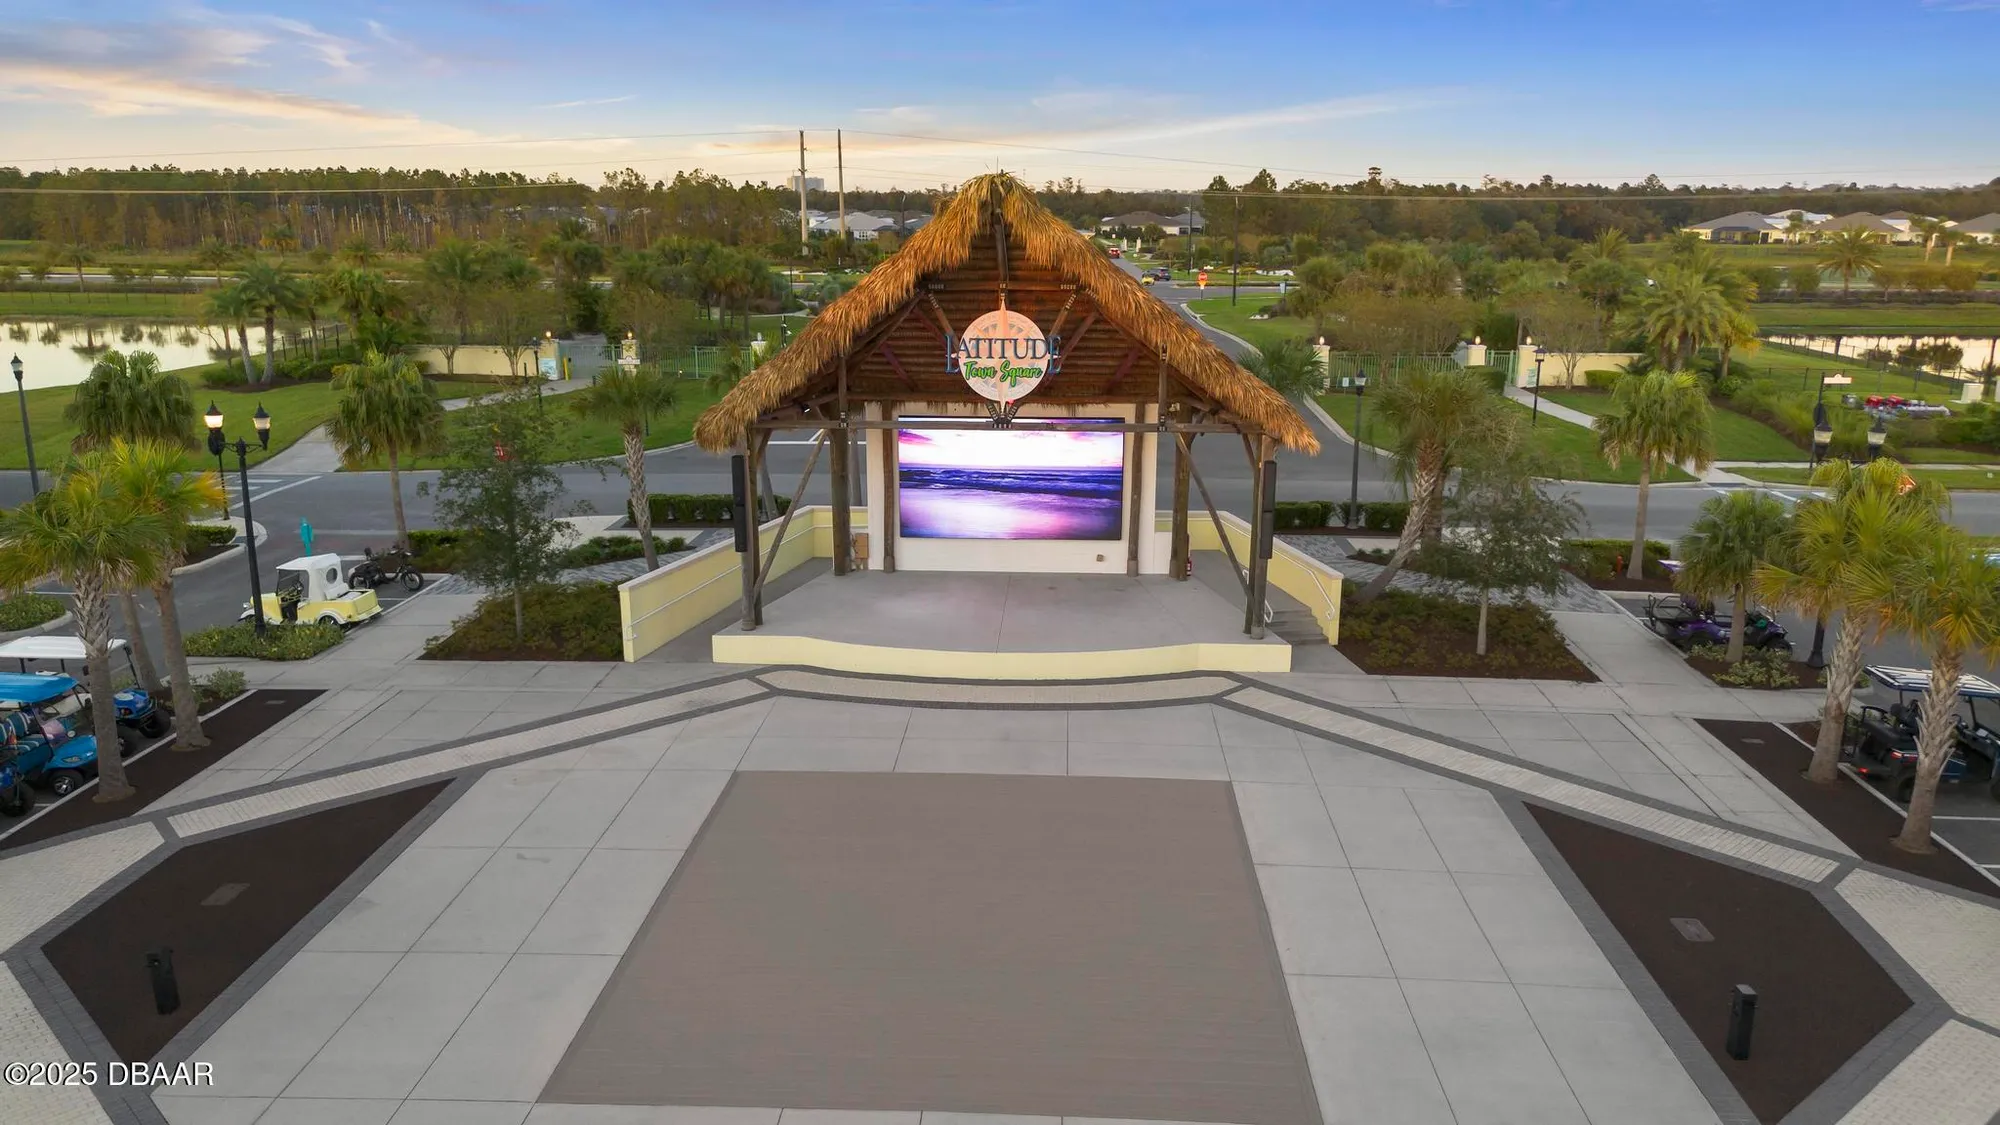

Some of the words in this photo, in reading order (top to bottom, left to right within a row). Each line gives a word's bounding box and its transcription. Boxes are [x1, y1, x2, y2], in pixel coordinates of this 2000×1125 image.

[945, 335, 1062, 374] LATITUDE
[964, 361, 997, 381] Town
[999, 360, 1043, 387] Square
